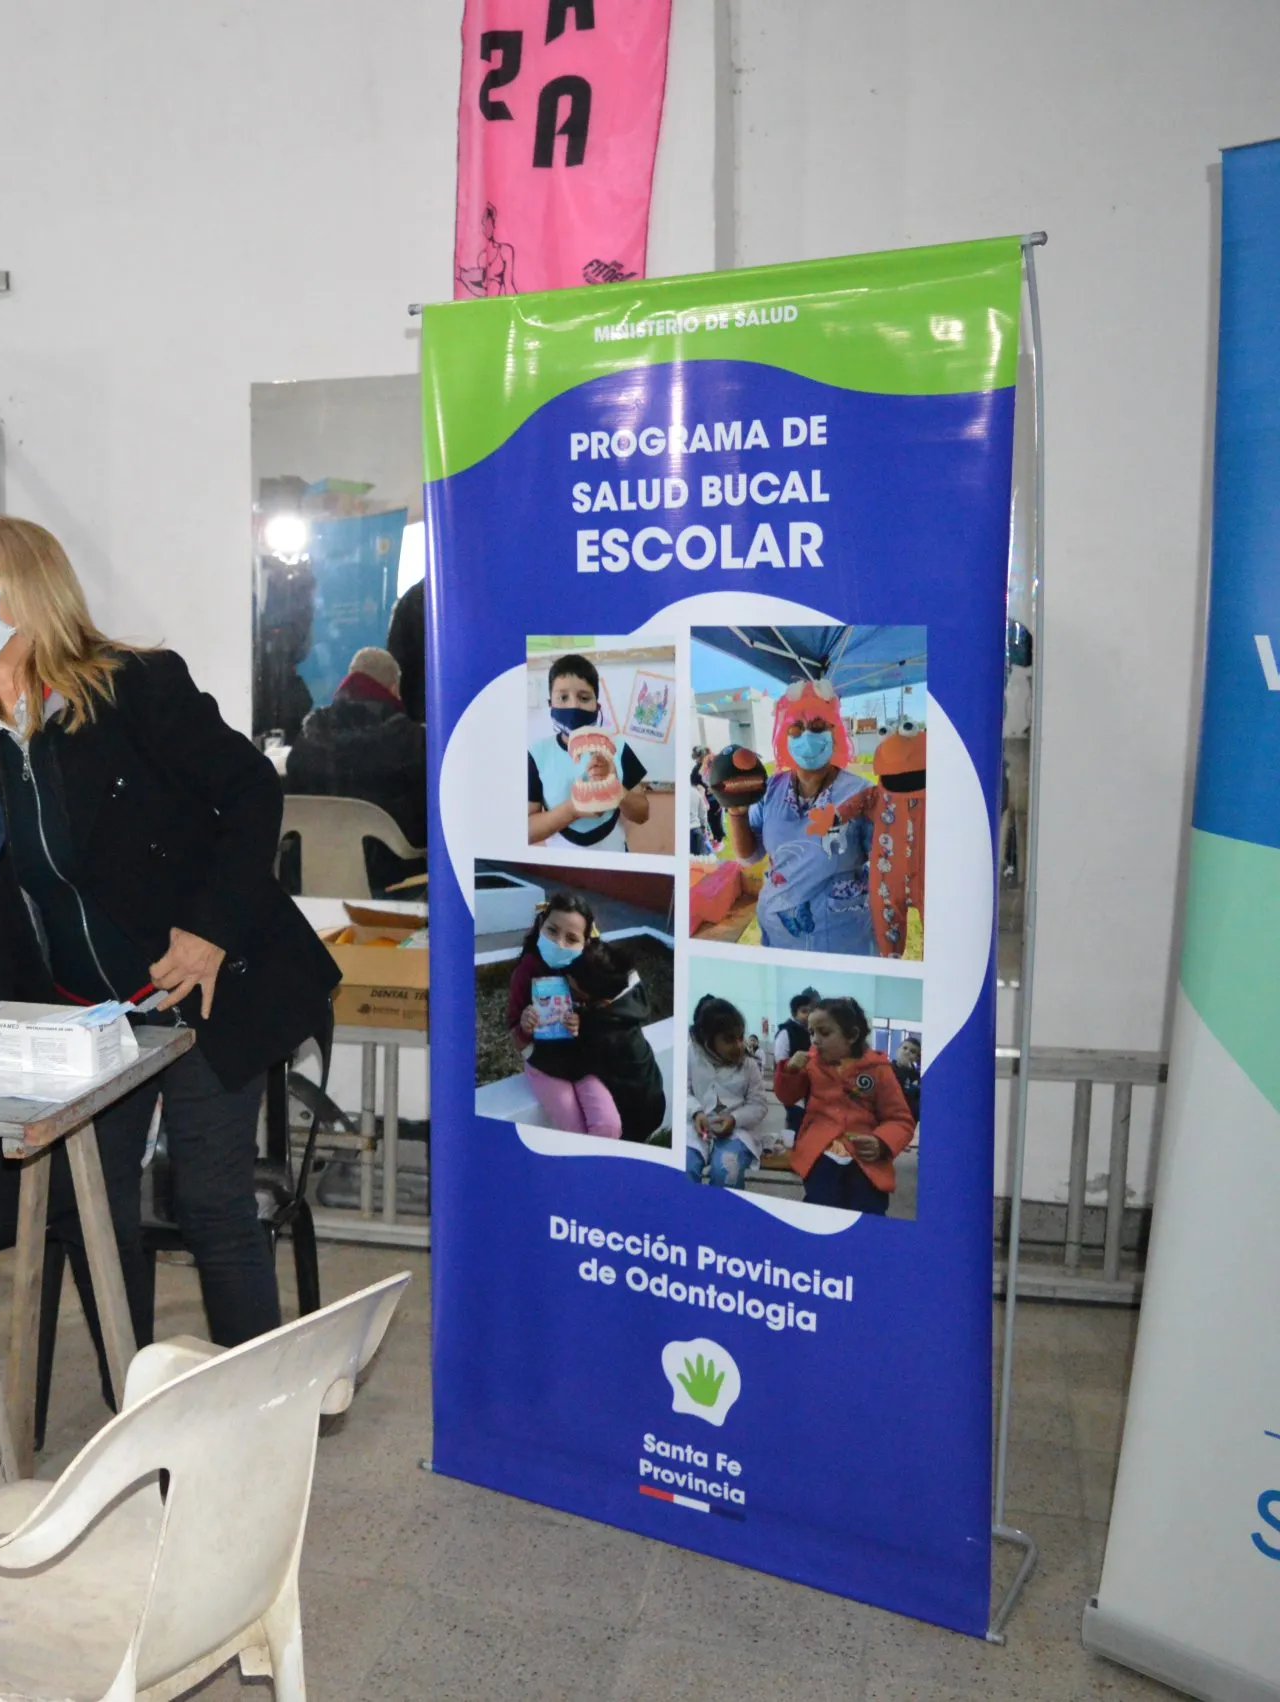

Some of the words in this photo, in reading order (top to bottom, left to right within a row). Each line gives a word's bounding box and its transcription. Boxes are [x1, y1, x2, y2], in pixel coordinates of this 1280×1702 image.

[594, 316, 700, 343] MINISTERIO
[705, 313, 729, 331] DE
[734, 305, 798, 328] SALUD
[570, 419, 770, 461] PROGRAMA
[782, 414, 828, 448] DE
[572, 478, 689, 513] SALUD
[701, 469, 831, 508] BUCAL
[576, 521, 825, 574] ESCOLAR
[550, 1215, 686, 1266] Dirección
[697, 1245, 853, 1302] Provincial
[579, 1258, 616, 1286] de
[625, 1266, 817, 1333] Odontologia
[643, 1433, 708, 1468] Santa
[716, 1452, 742, 1477] Fe
[639, 1458, 745, 1505] Provincia
